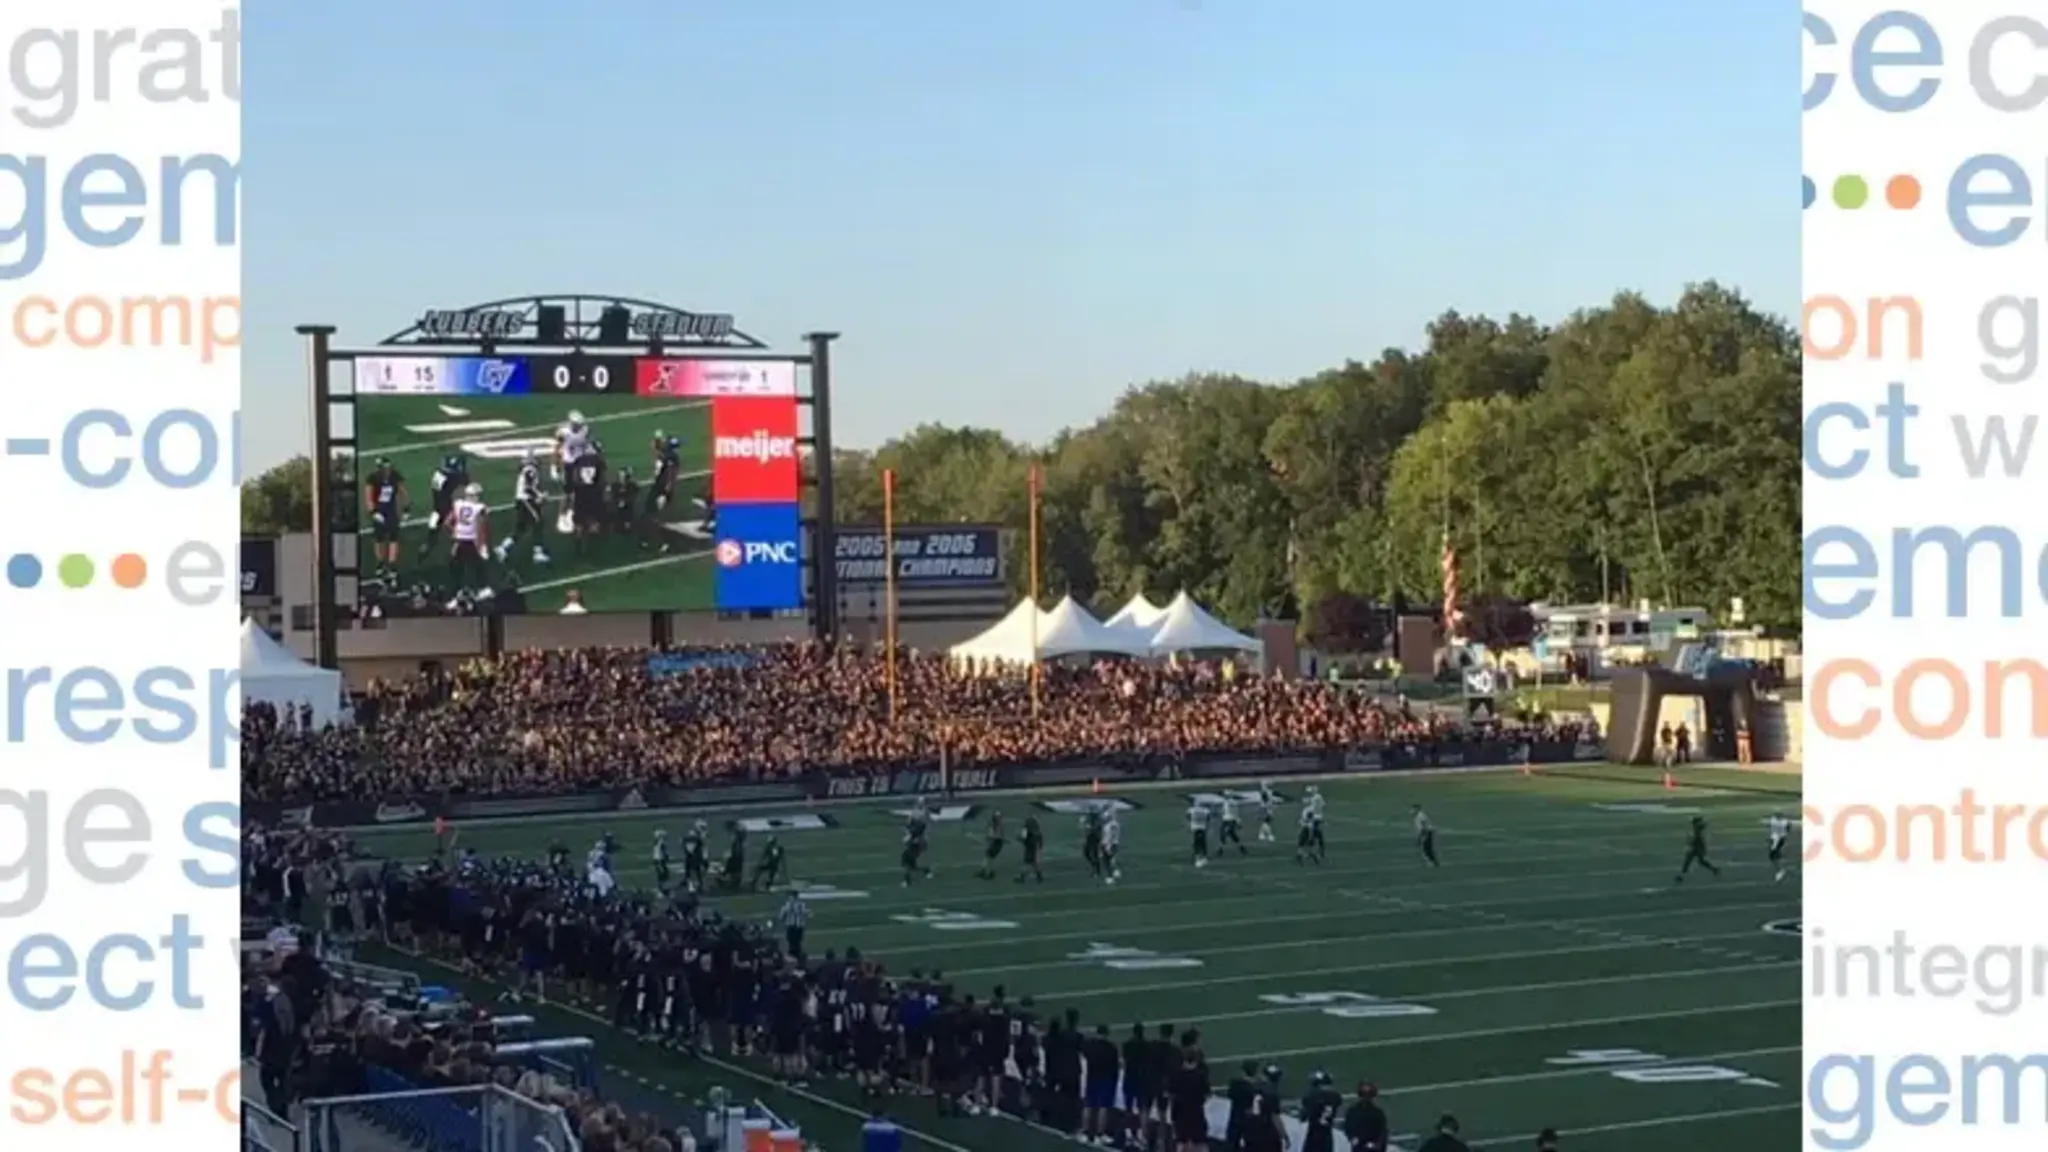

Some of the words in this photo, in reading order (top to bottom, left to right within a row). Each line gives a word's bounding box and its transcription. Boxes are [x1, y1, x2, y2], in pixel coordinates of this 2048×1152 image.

[715, 428, 796, 464] meijer
[744, 541, 797, 564] PNC
[919, 769, 1000, 791] FOTBALL
